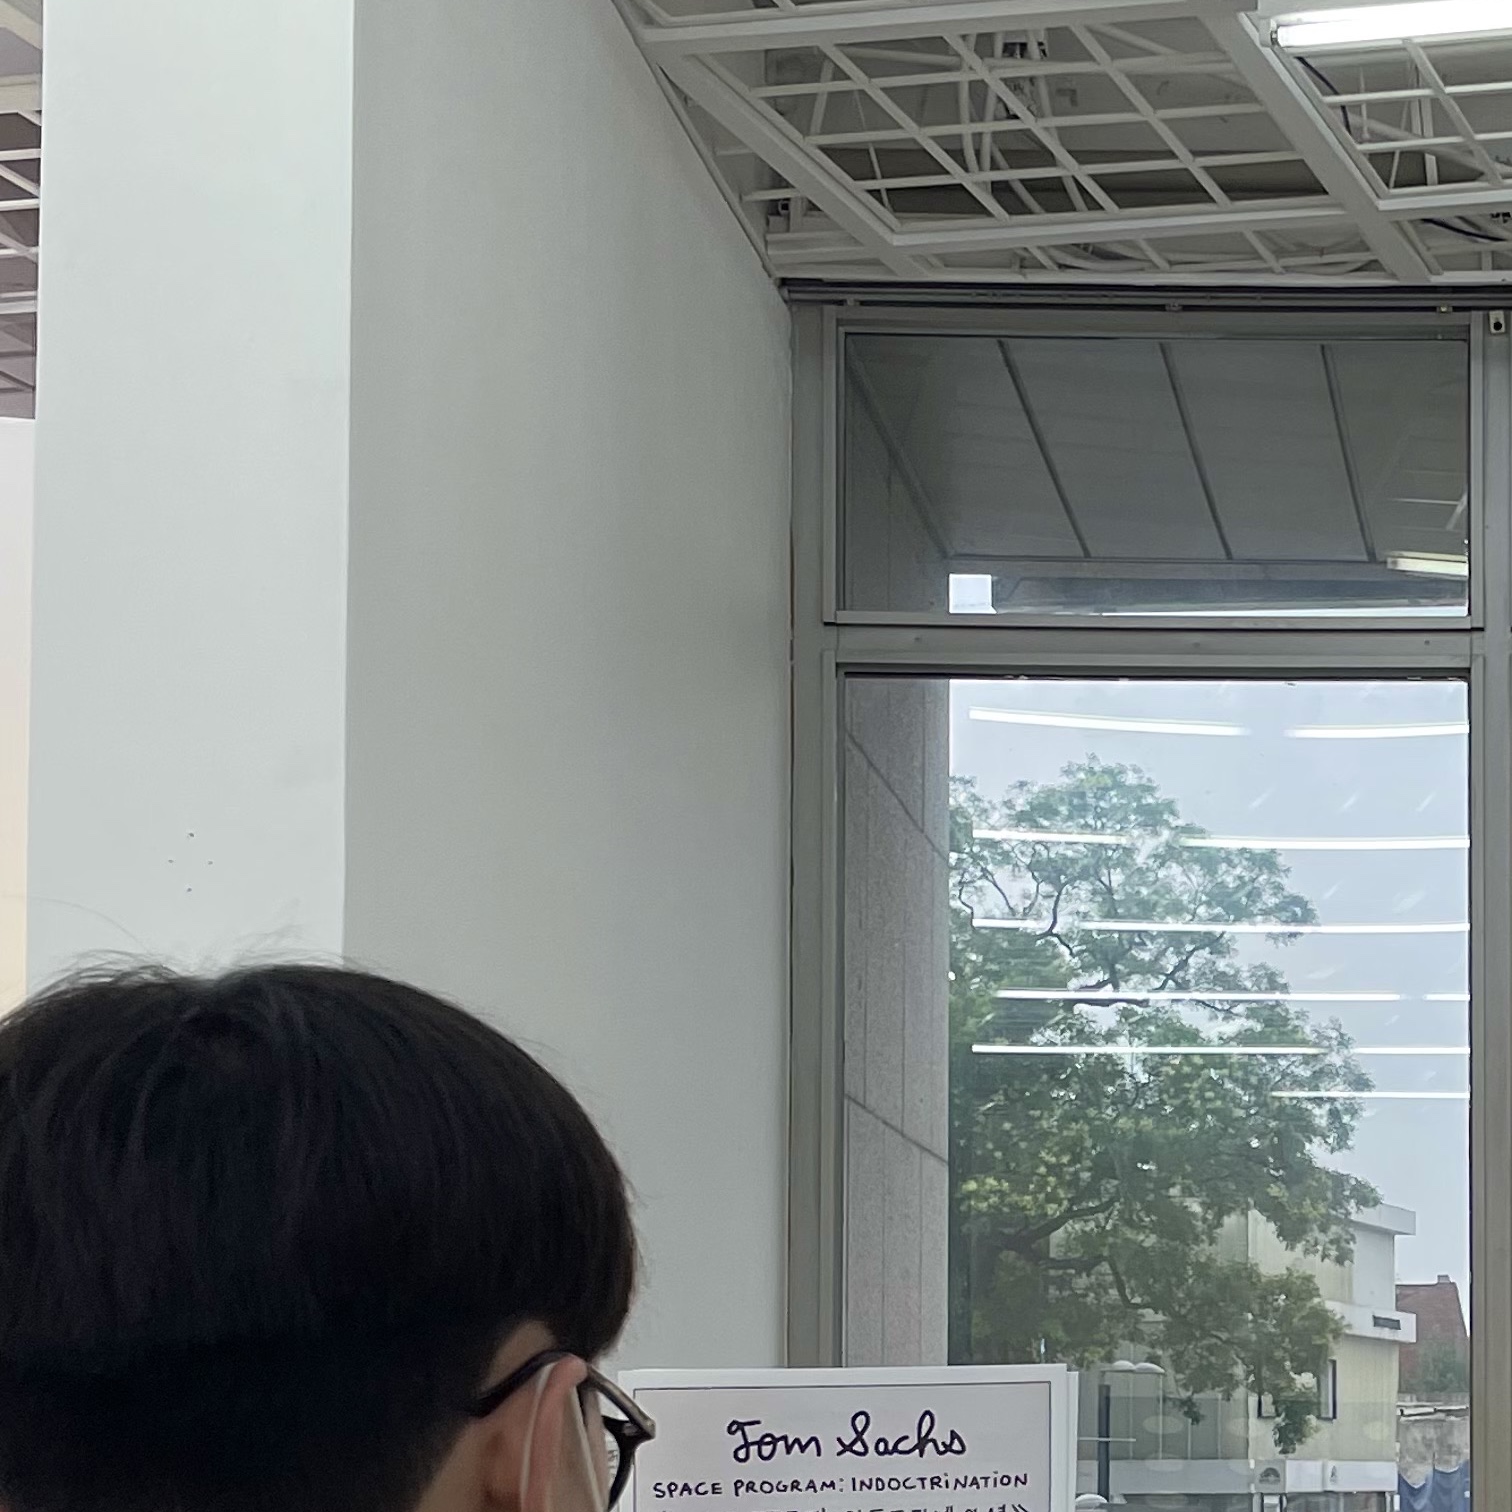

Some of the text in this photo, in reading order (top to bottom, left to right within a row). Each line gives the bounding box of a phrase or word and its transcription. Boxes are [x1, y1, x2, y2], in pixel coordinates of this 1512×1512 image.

[727, 1410, 967, 1463] Tom Sachs
[653, 1480, 723, 1499] SPACE
[733, 1477, 844, 1497] PROGRAM:
